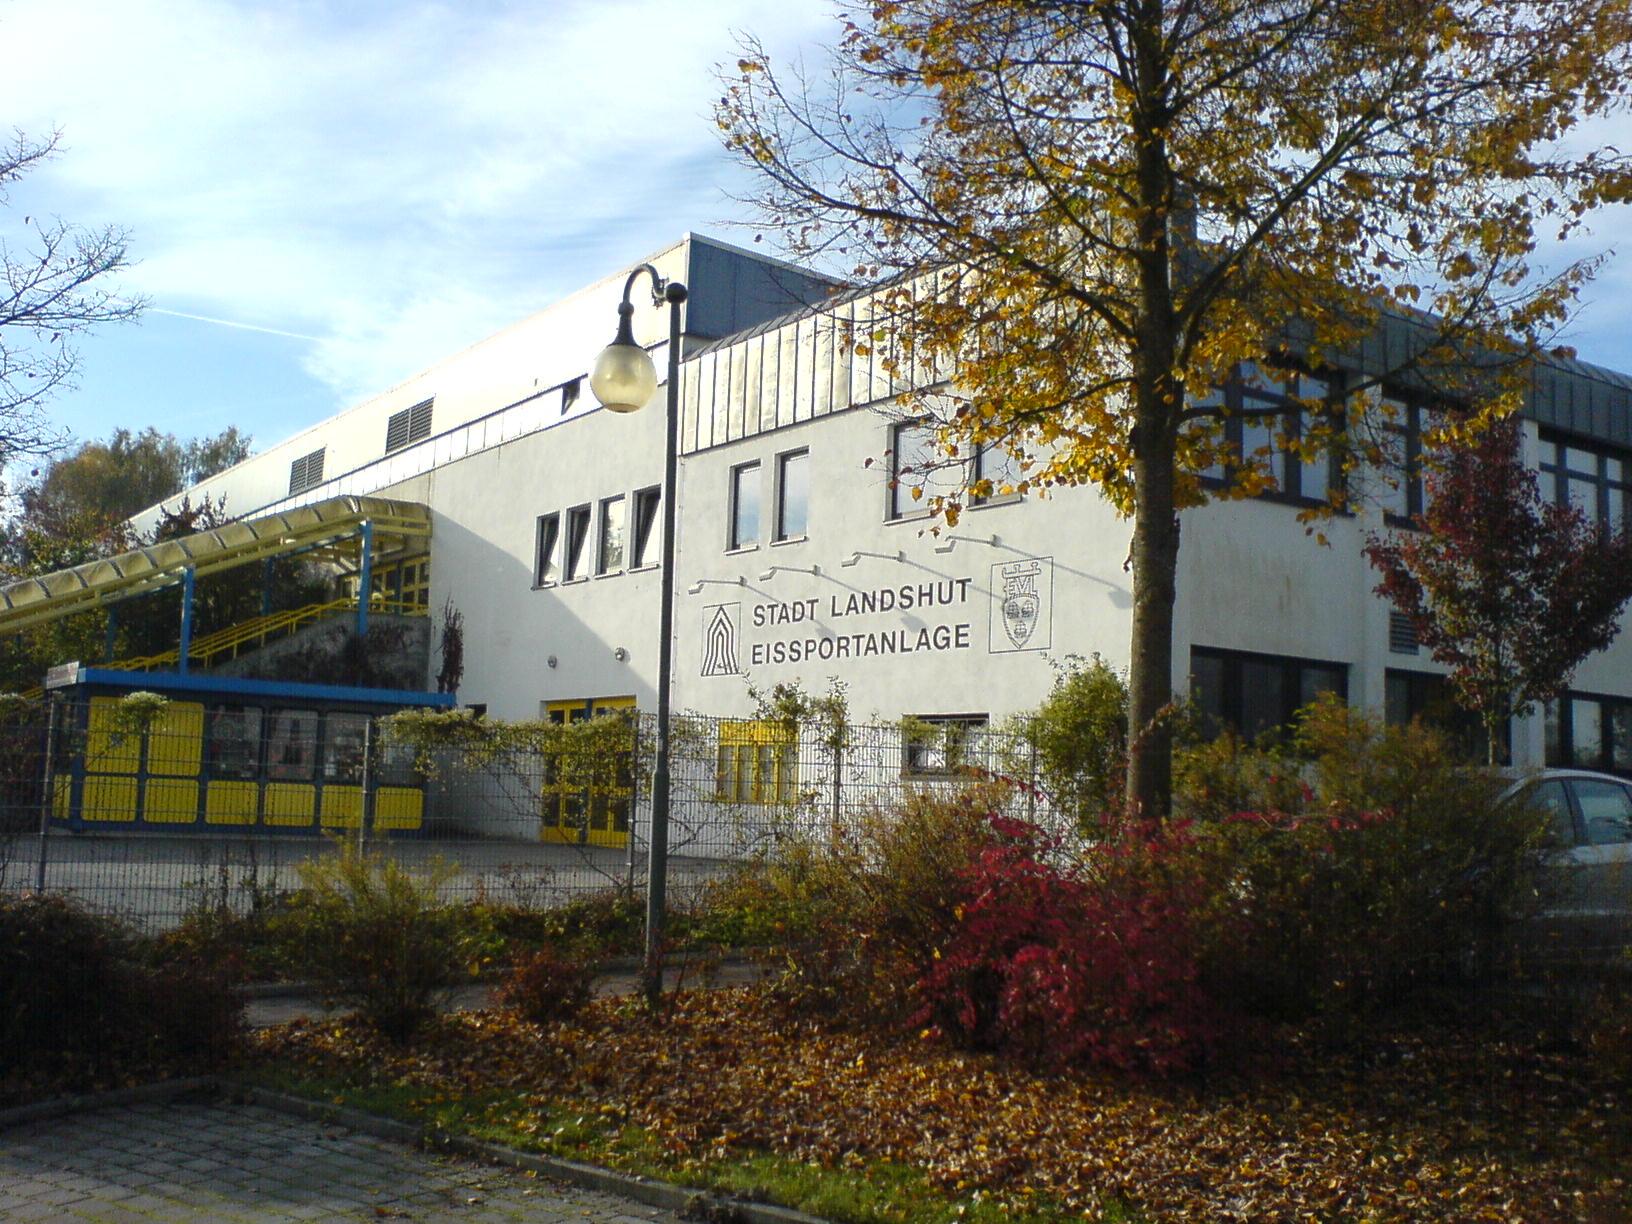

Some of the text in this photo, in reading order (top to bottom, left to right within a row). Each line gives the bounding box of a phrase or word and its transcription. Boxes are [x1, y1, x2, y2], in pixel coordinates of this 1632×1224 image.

[752, 578, 972, 626] STADT LANDSHUT
[751, 624, 970, 665] EISSPORTANLAGE
